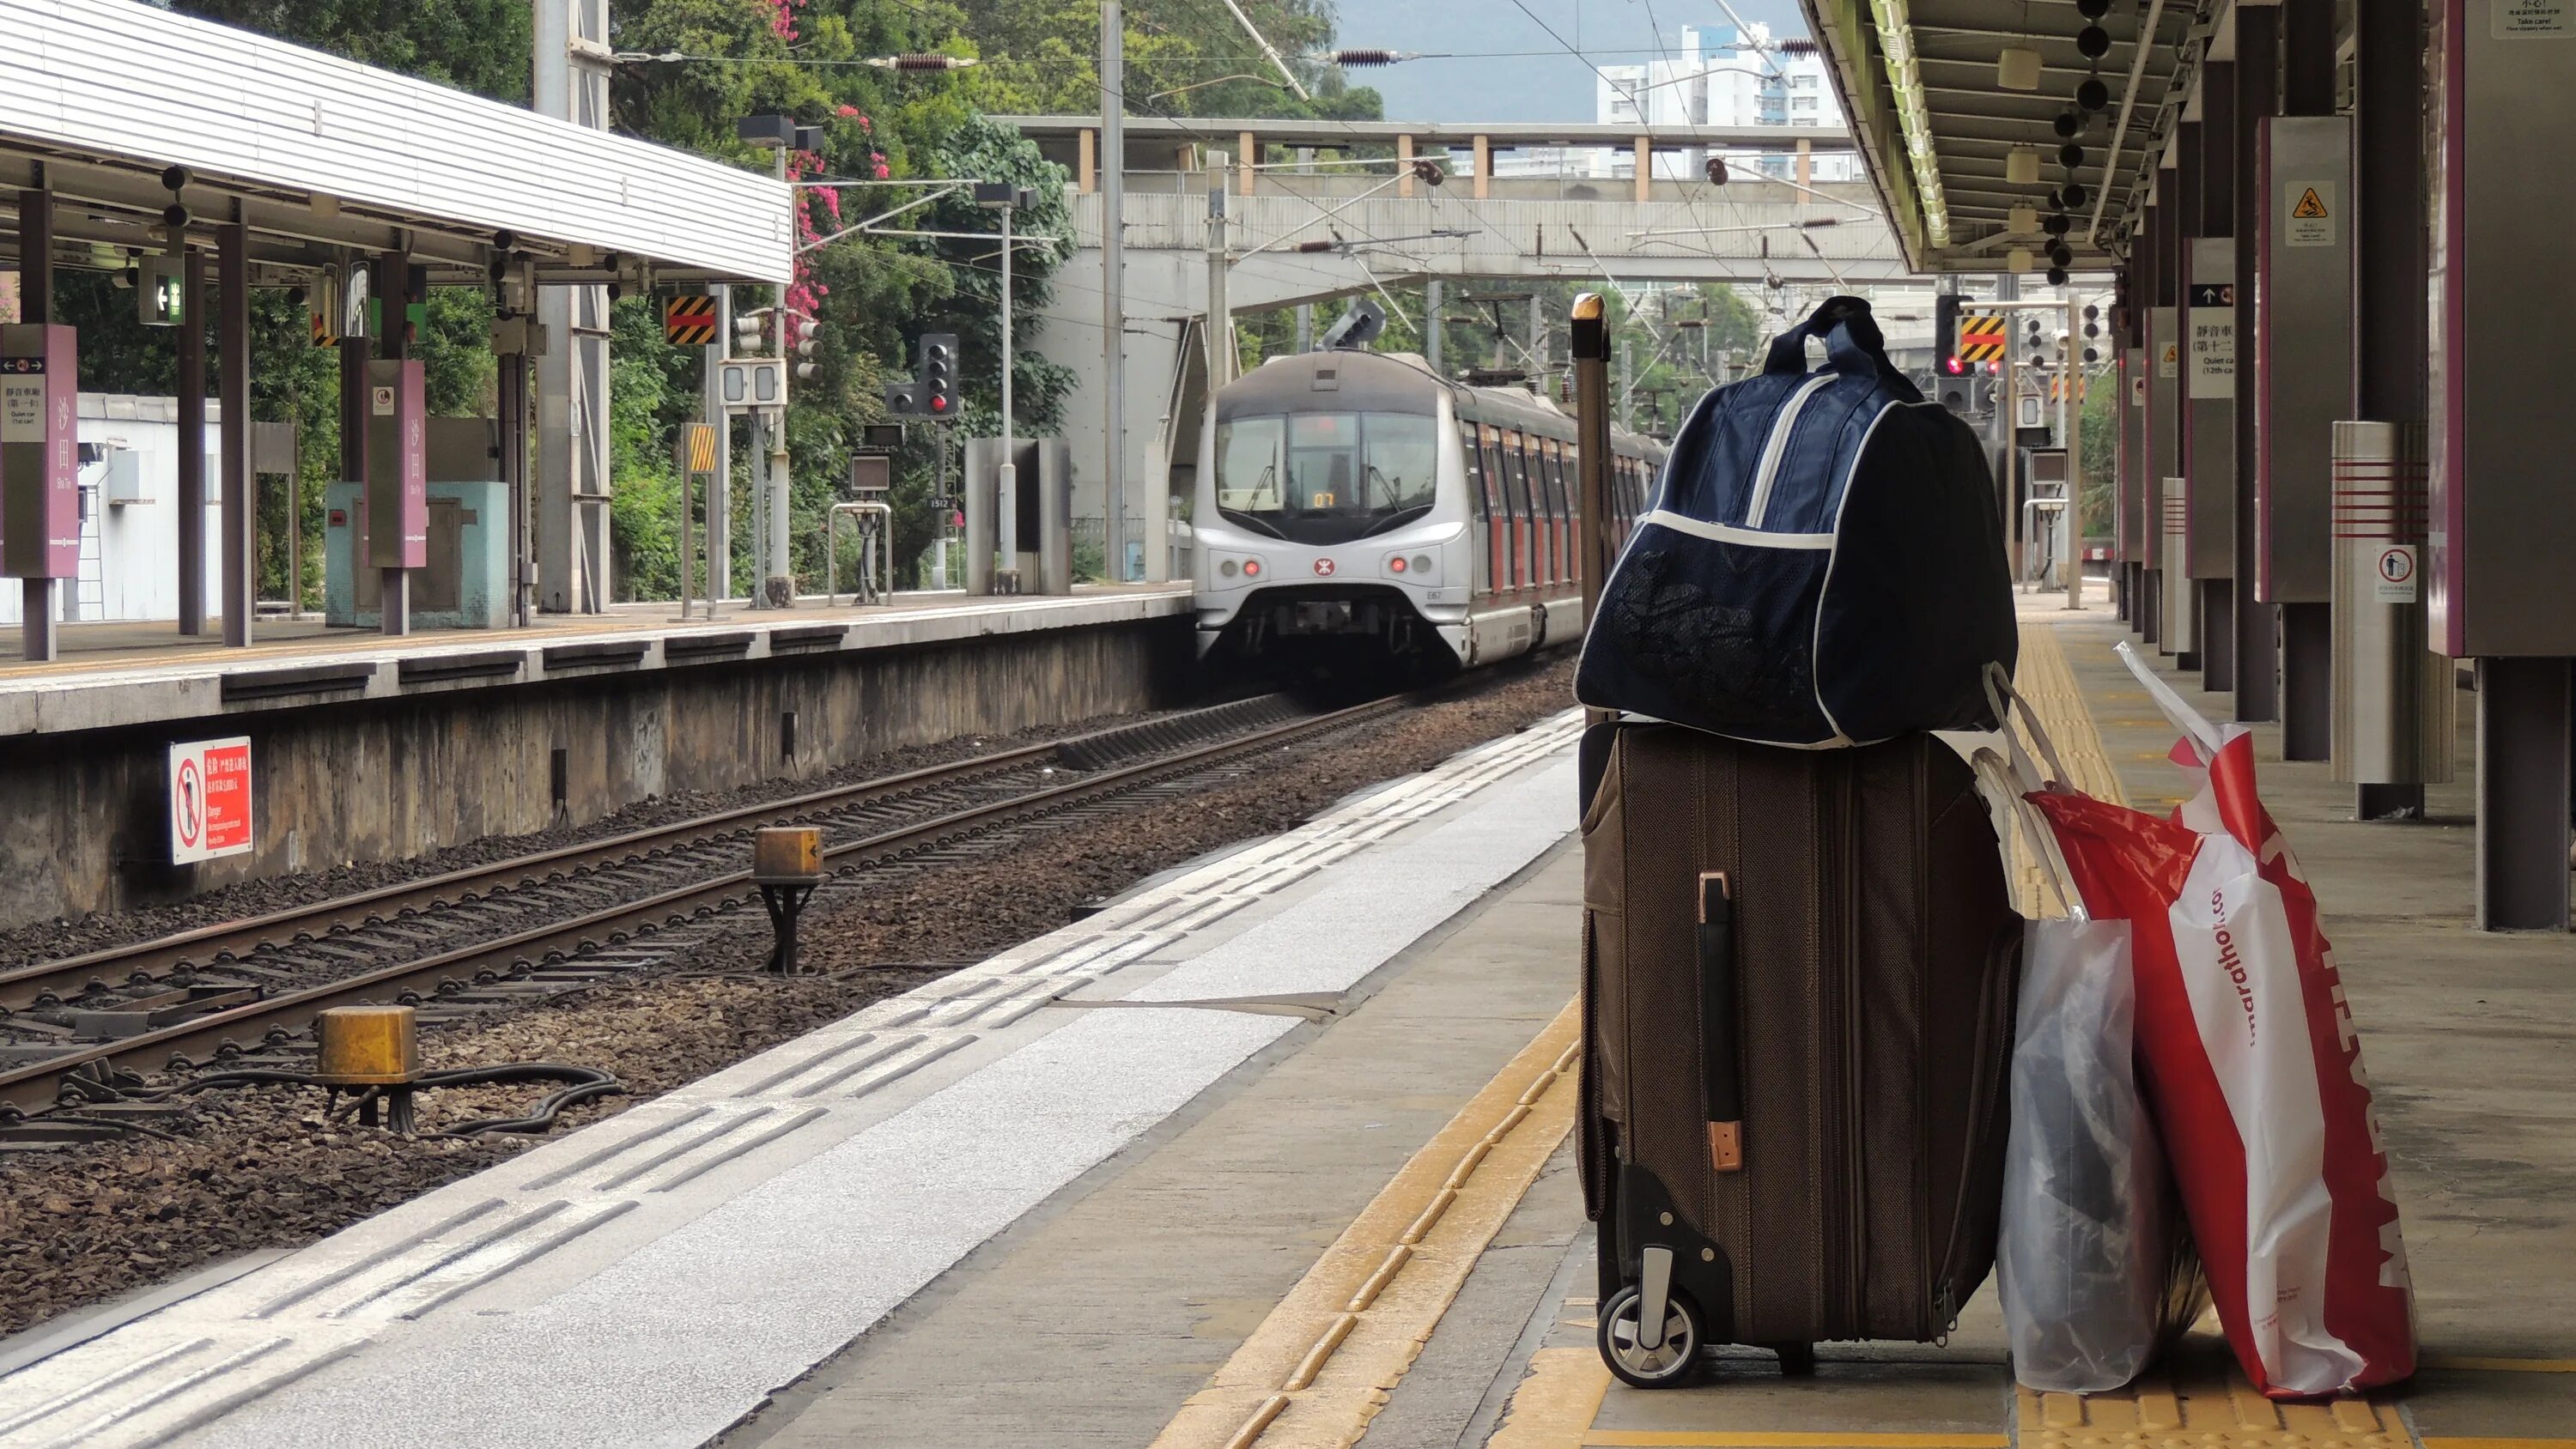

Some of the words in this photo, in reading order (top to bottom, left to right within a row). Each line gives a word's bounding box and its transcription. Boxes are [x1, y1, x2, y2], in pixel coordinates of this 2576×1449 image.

[2202, 367, 2223, 375] (12th
[58, 397, 70, 470] 沙田
[931, 500, 949, 508] 1512
[1315, 494, 1334, 508] 07
[1427, 591, 1442, 600] E67
